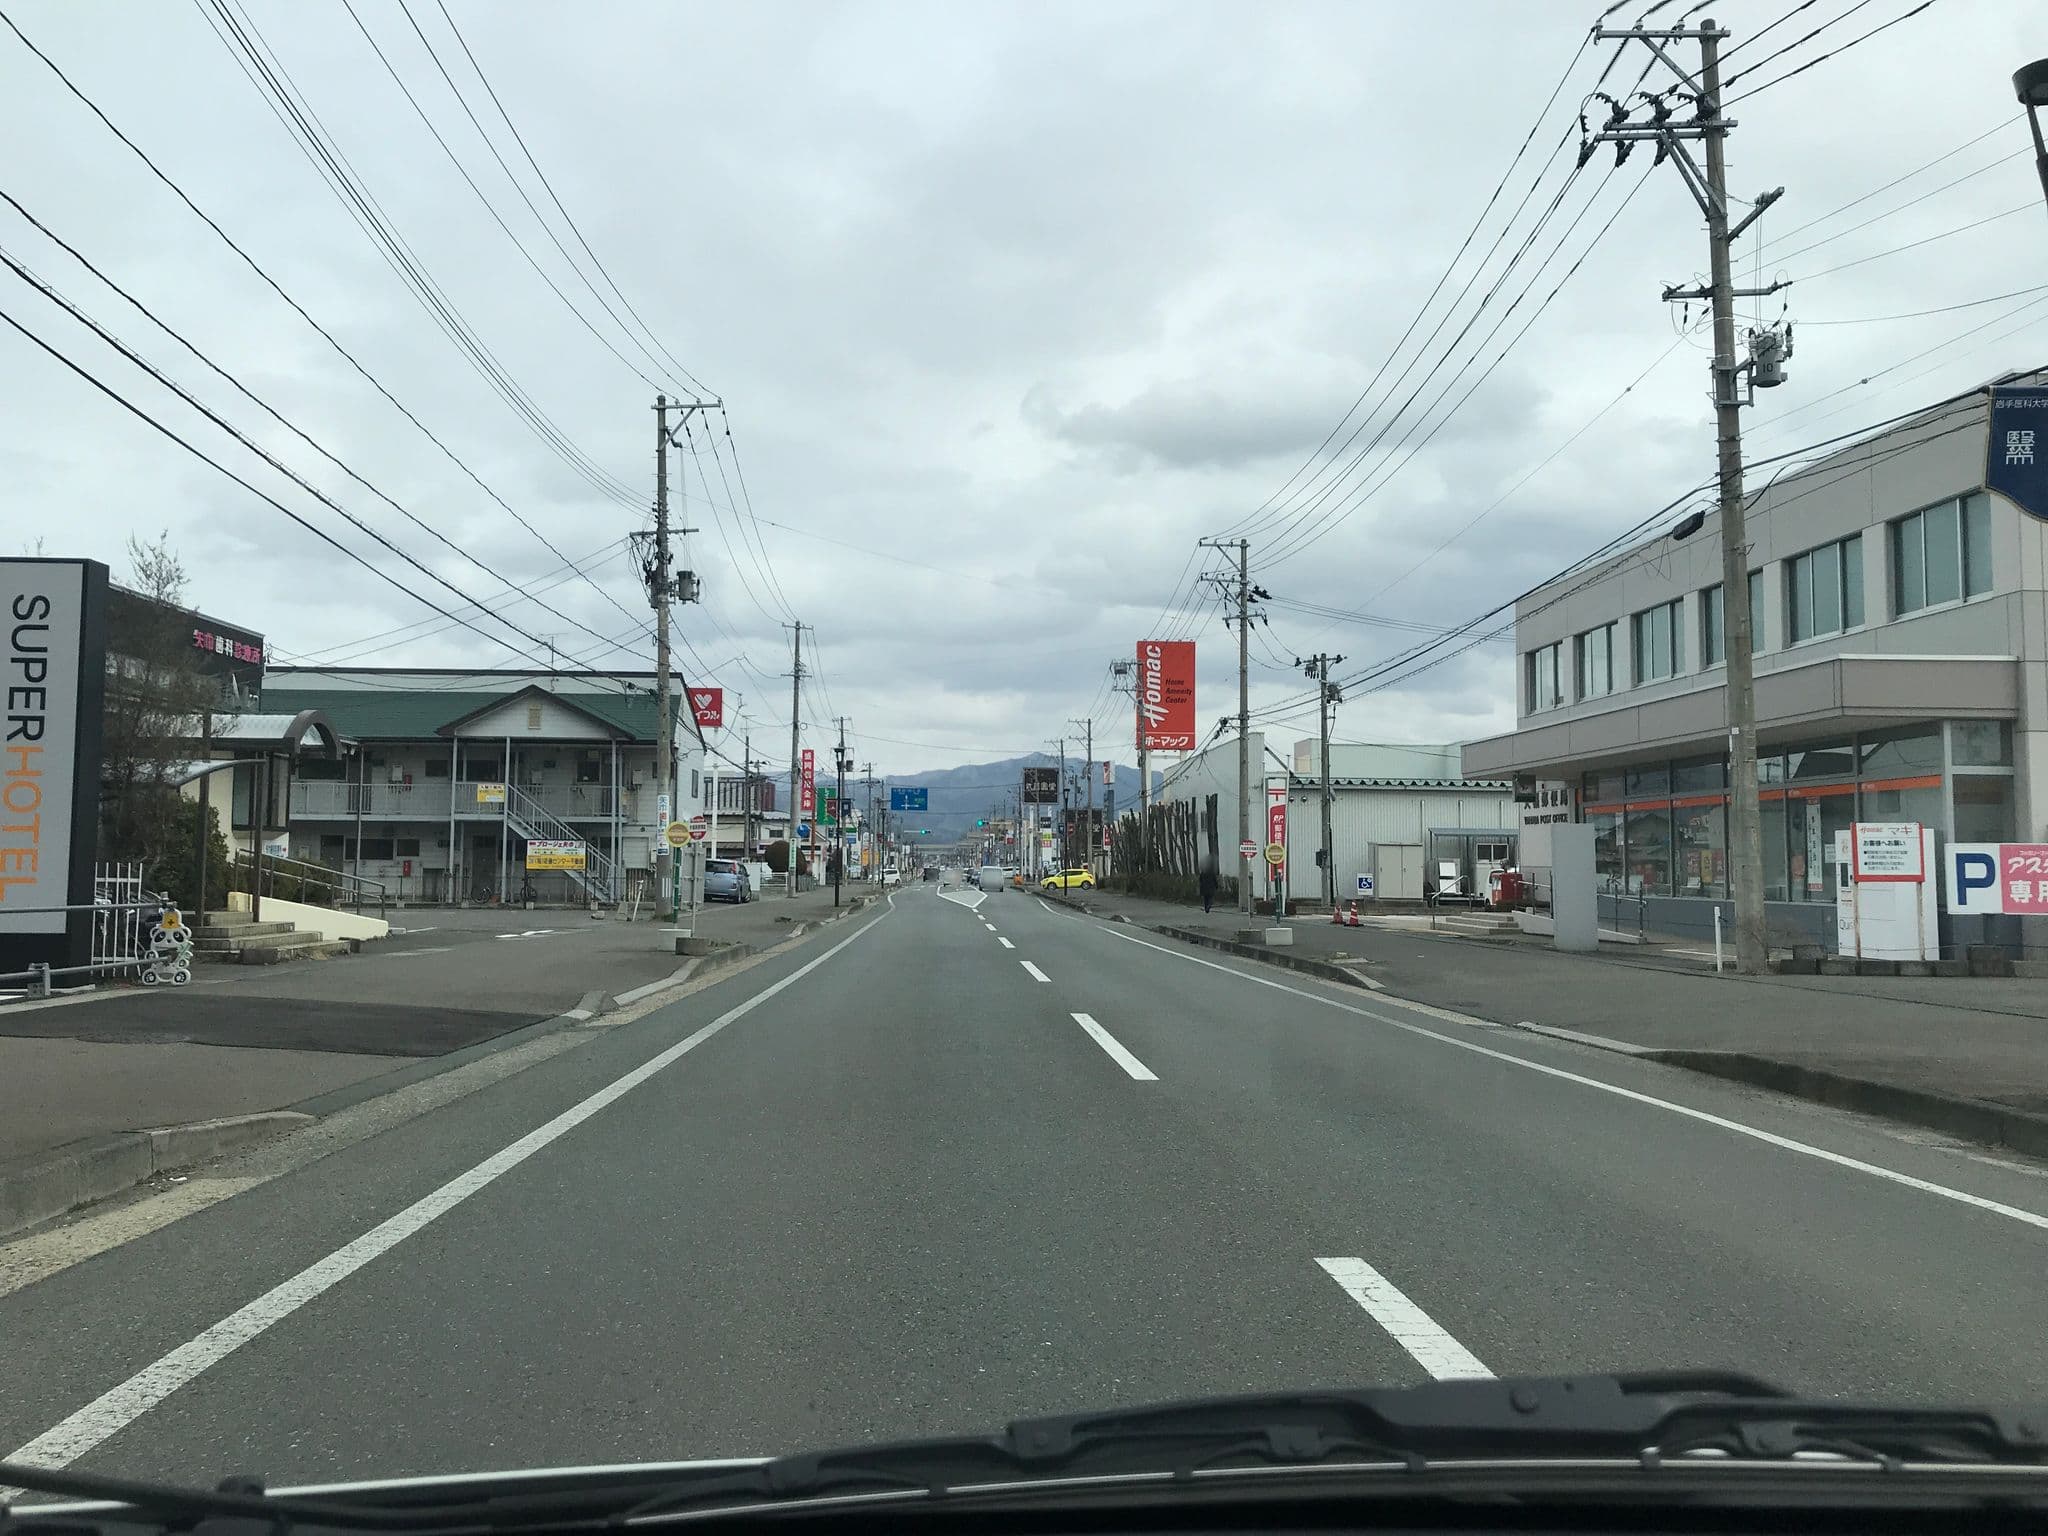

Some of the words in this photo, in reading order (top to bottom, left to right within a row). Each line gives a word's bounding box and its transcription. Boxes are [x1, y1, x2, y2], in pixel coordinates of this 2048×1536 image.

[1142, 644, 1169, 729] Homac
[1165, 678, 1184, 686] Home
[695, 709, 720, 720] イフル
[1145, 736, 1189, 747] ホーマック
[2008, 856, 2048, 874] アス
[1956, 852, 1996, 906] P
